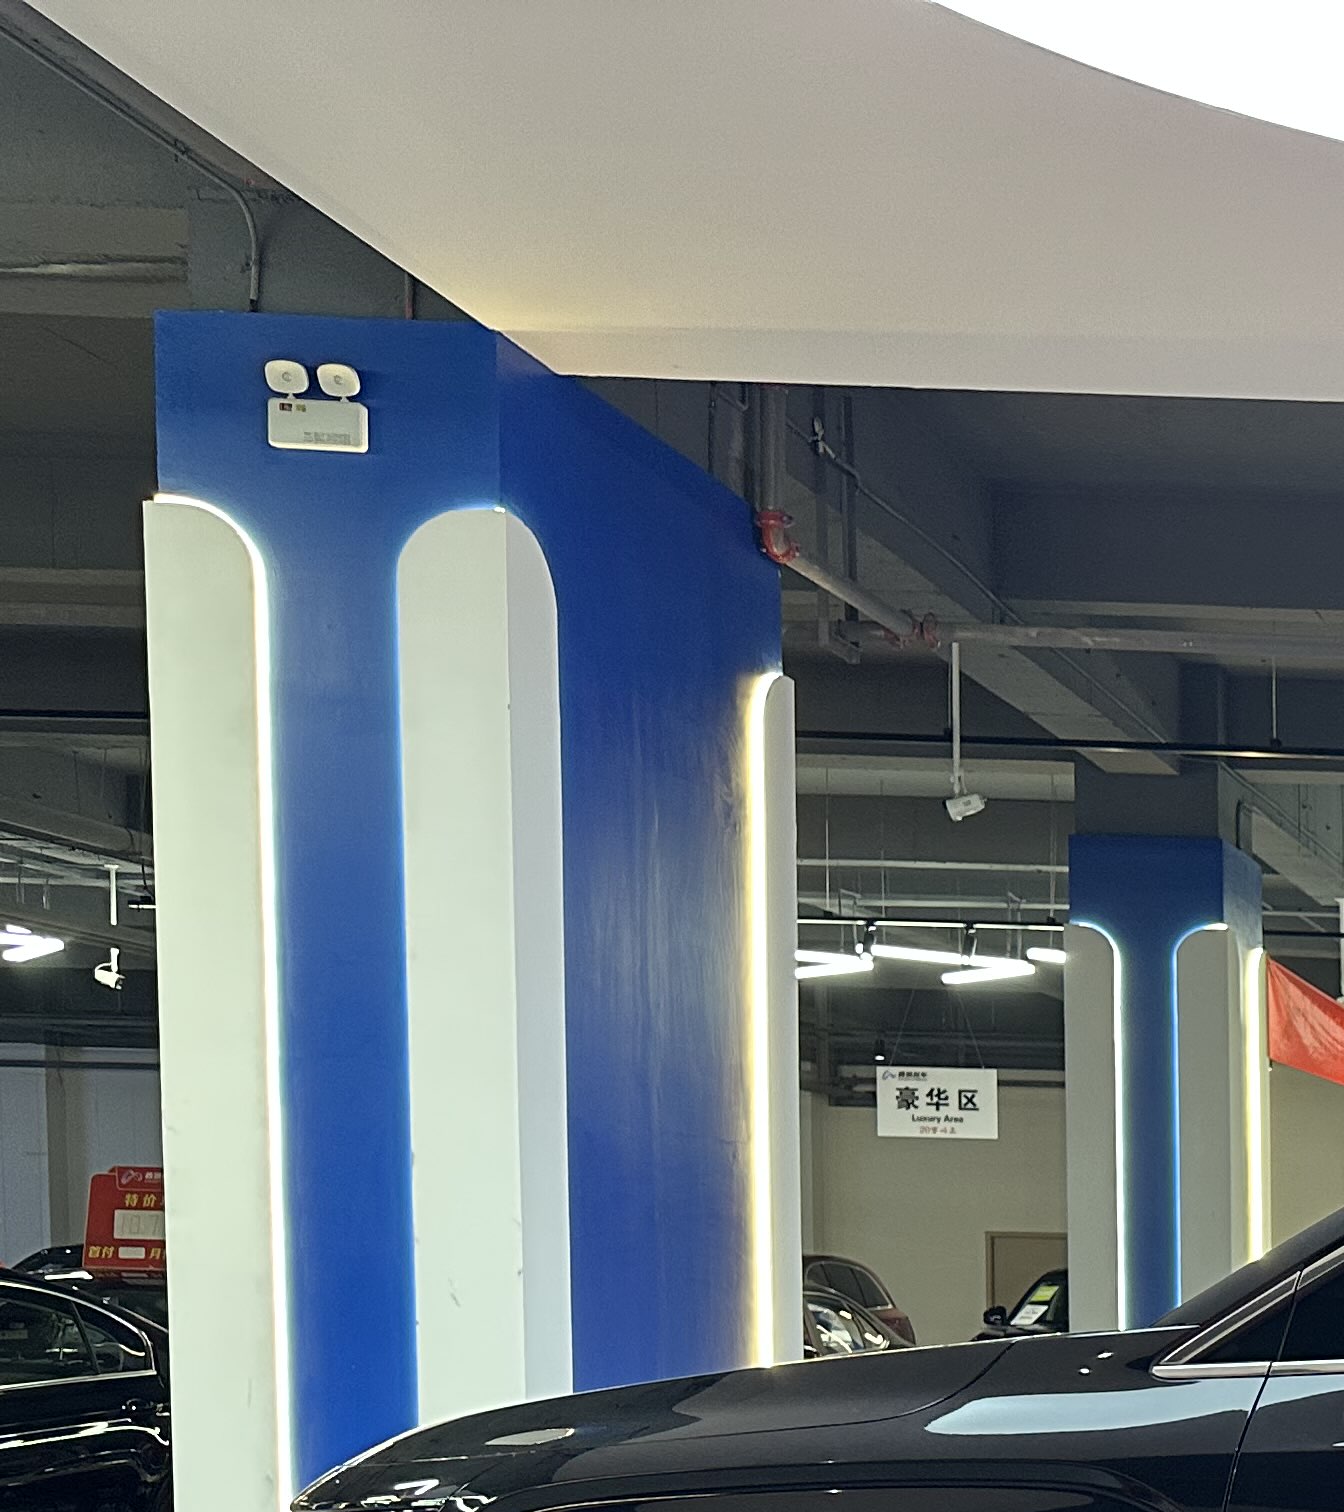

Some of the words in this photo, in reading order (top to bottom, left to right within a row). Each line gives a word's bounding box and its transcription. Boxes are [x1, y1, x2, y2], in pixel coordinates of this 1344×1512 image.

[896, 1086, 979, 1111] 豪华区
[911, 1114, 941, 1124] Luxury
[943, 1114, 964, 1123] Area
[125, 1193, 163, 1207] 特价
[150, 1248, 164, 1259] 月
